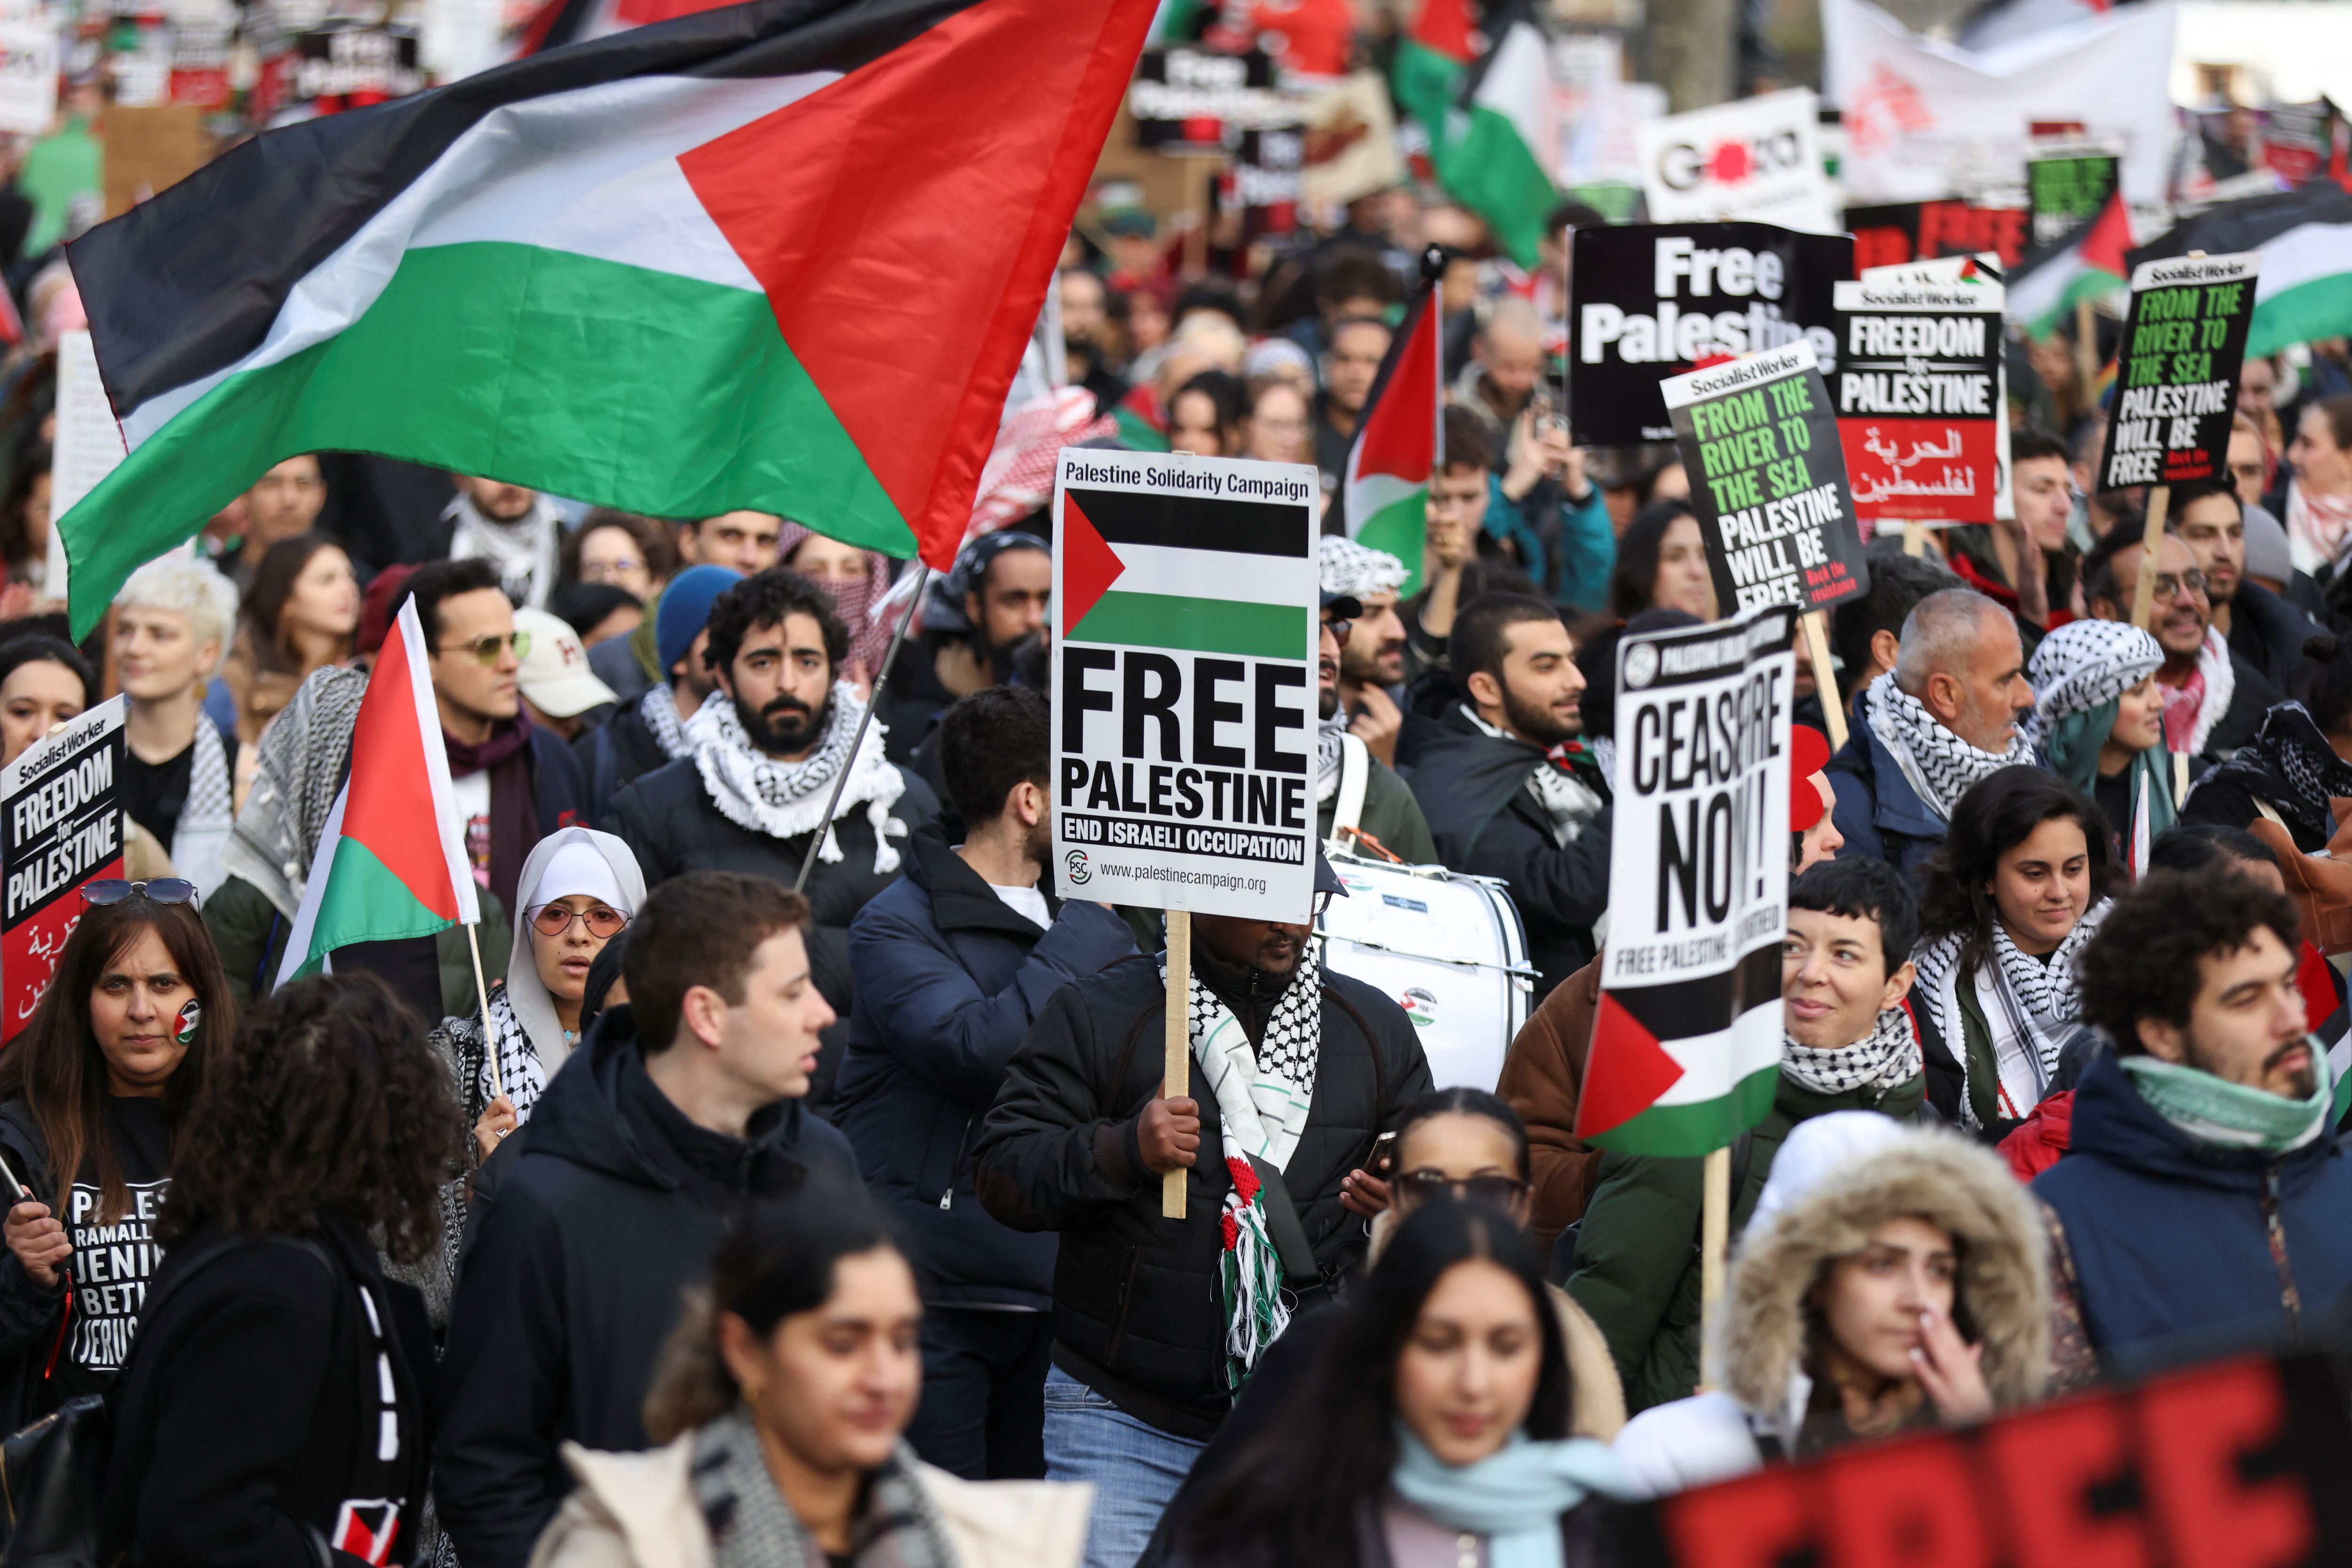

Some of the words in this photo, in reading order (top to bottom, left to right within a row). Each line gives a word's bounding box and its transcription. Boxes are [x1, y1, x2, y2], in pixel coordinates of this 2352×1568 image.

[1654, 237, 1785, 300] Free
[2137, 287, 2201, 323] FROM
[2206, 282, 2245, 317] THE
[1581, 302, 1837, 375] Palestine
[1849, 316, 1986, 357] FREEDOM
[2131, 320, 2196, 356] RIVER
[2200, 317, 2228, 350] TO
[1691, 365, 1757, 395] Socialist
[1755, 354, 1799, 377] Worker
[2127, 353, 2167, 389] THE
[2170, 352, 2211, 386] SEA
[1689, 389, 1770, 442] FROM
[1767, 375, 1814, 419] THE
[1840, 373, 1992, 414] PALESTINE
[2120, 379, 2231, 421] PALESTINE
[1700, 427, 1780, 478] RIVER
[1778, 415, 1812, 455] TO
[1863, 426, 1963, 467] الحرية
[2115, 418, 2163, 453] WILL
[2168, 416, 2200, 450] BE
[1066, 462, 1141, 485] Palestine
[1146, 467, 1222, 495] Solidarity
[1227, 473, 1309, 501] Campaign
[1708, 469, 1765, 515] THE
[1766, 455, 1813, 499] SEA
[1850, 464, 1976, 503] لفلسطين
[2107, 450, 2162, 488] FREE
[1717, 482, 1843, 551] PALESTINE
[1725, 539, 1798, 588] WILL
[1795, 527, 1829, 569] BE
[1735, 573, 1806, 611] FREE
[1062, 646, 1307, 775] FREE
[1634, 666, 1782, 796] CEASRE
[19, 742, 66, 785] Socialist
[67, 718, 106, 754] Worker
[13, 743, 113, 849] FREEDOM
[1061, 757, 1306, 829] PALESTINE
[56, 819, 75, 844] for
[1065, 817, 1102, 842] END
[1108, 821, 1181, 849] ISRAELI
[1186, 829, 1302, 862] OCCUPATION
[1655, 769, 1767, 933] NO!
[8, 807, 118, 920] PALESTINE
[1070, 862, 1088, 875] PSC
[1100, 863, 1266, 894] www.palestinecampaign.org
[1615, 945, 1655, 976] FREE
[1661, 933, 1727, 972] PALESTINE
[75, 1223, 153, 1248] RAMALL
